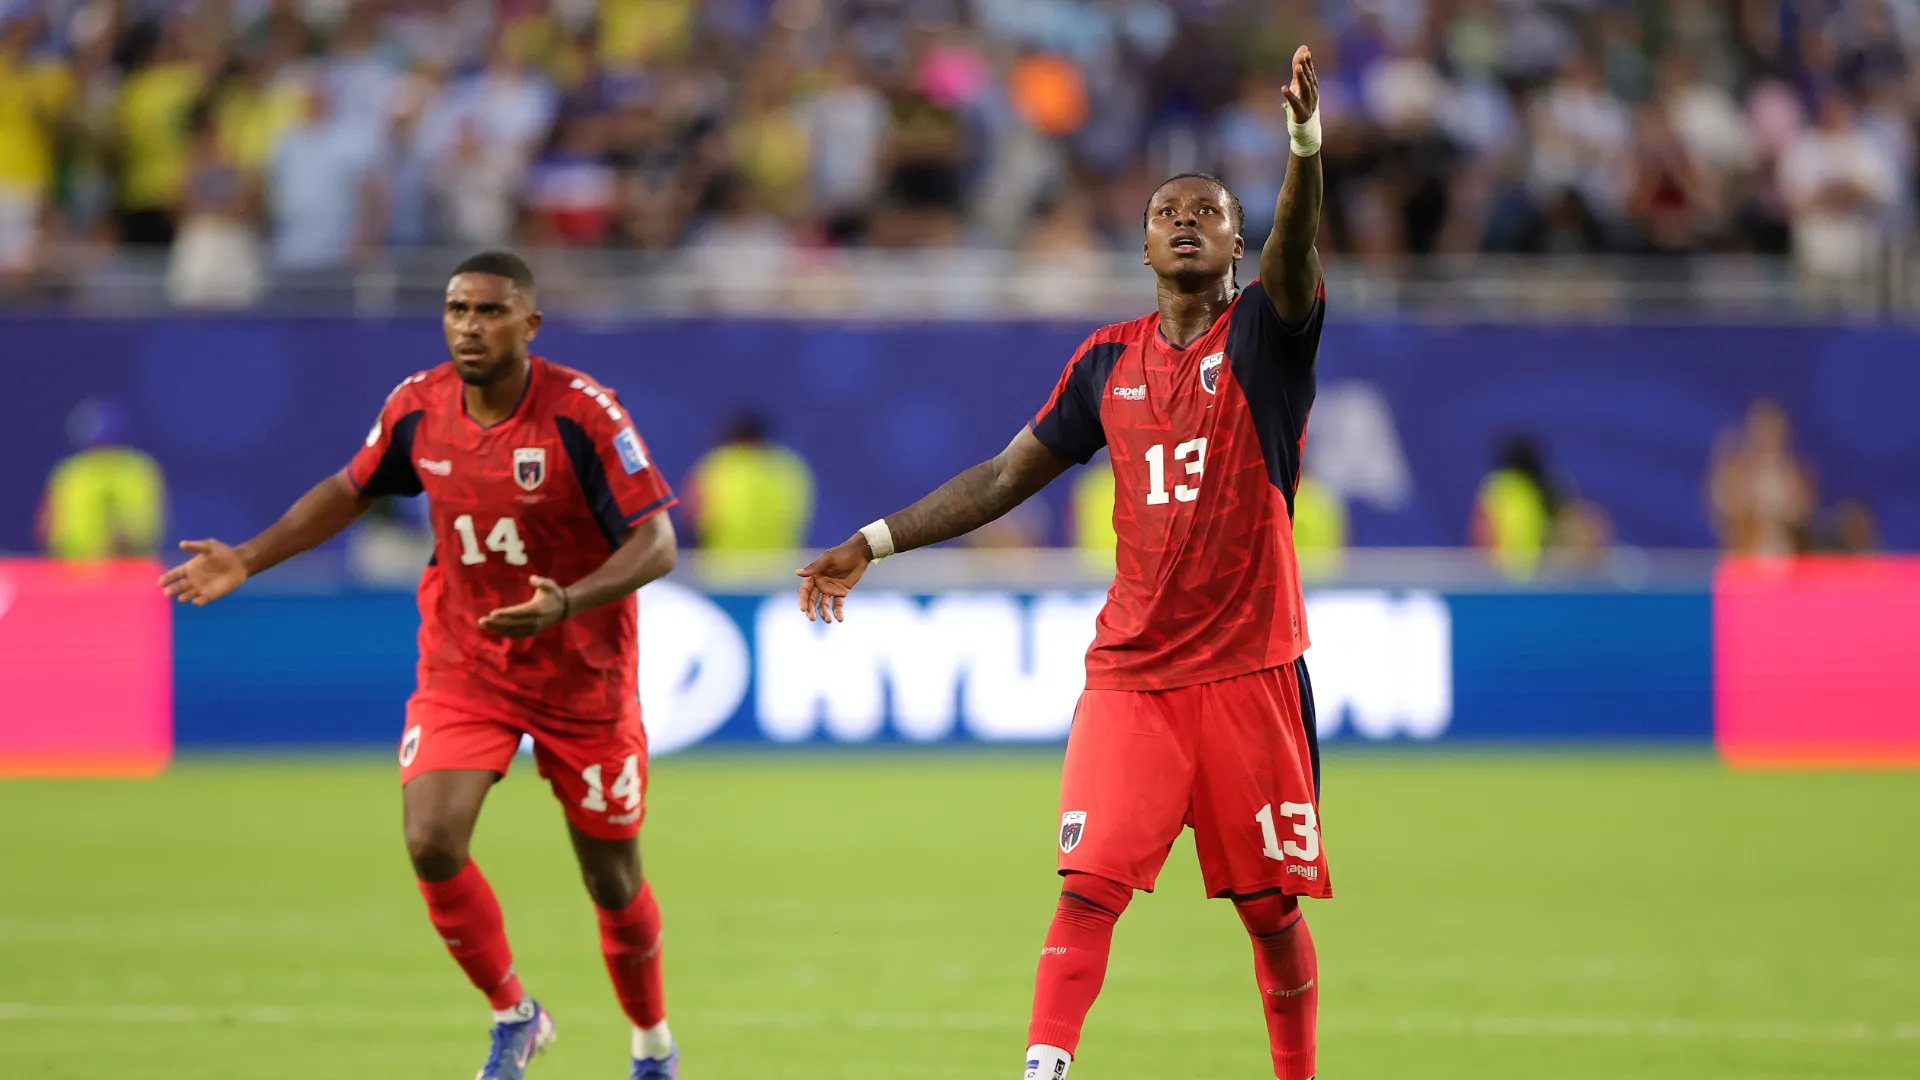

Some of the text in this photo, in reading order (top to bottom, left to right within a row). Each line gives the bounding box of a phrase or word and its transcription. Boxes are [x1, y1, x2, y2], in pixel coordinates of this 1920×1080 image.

[1113, 384, 1147, 399] capelli
[1145, 437, 1208, 505] 13
[454, 514, 528, 566] 14
[581, 754, 641, 812] 14
[1255, 801, 1320, 862] 13
